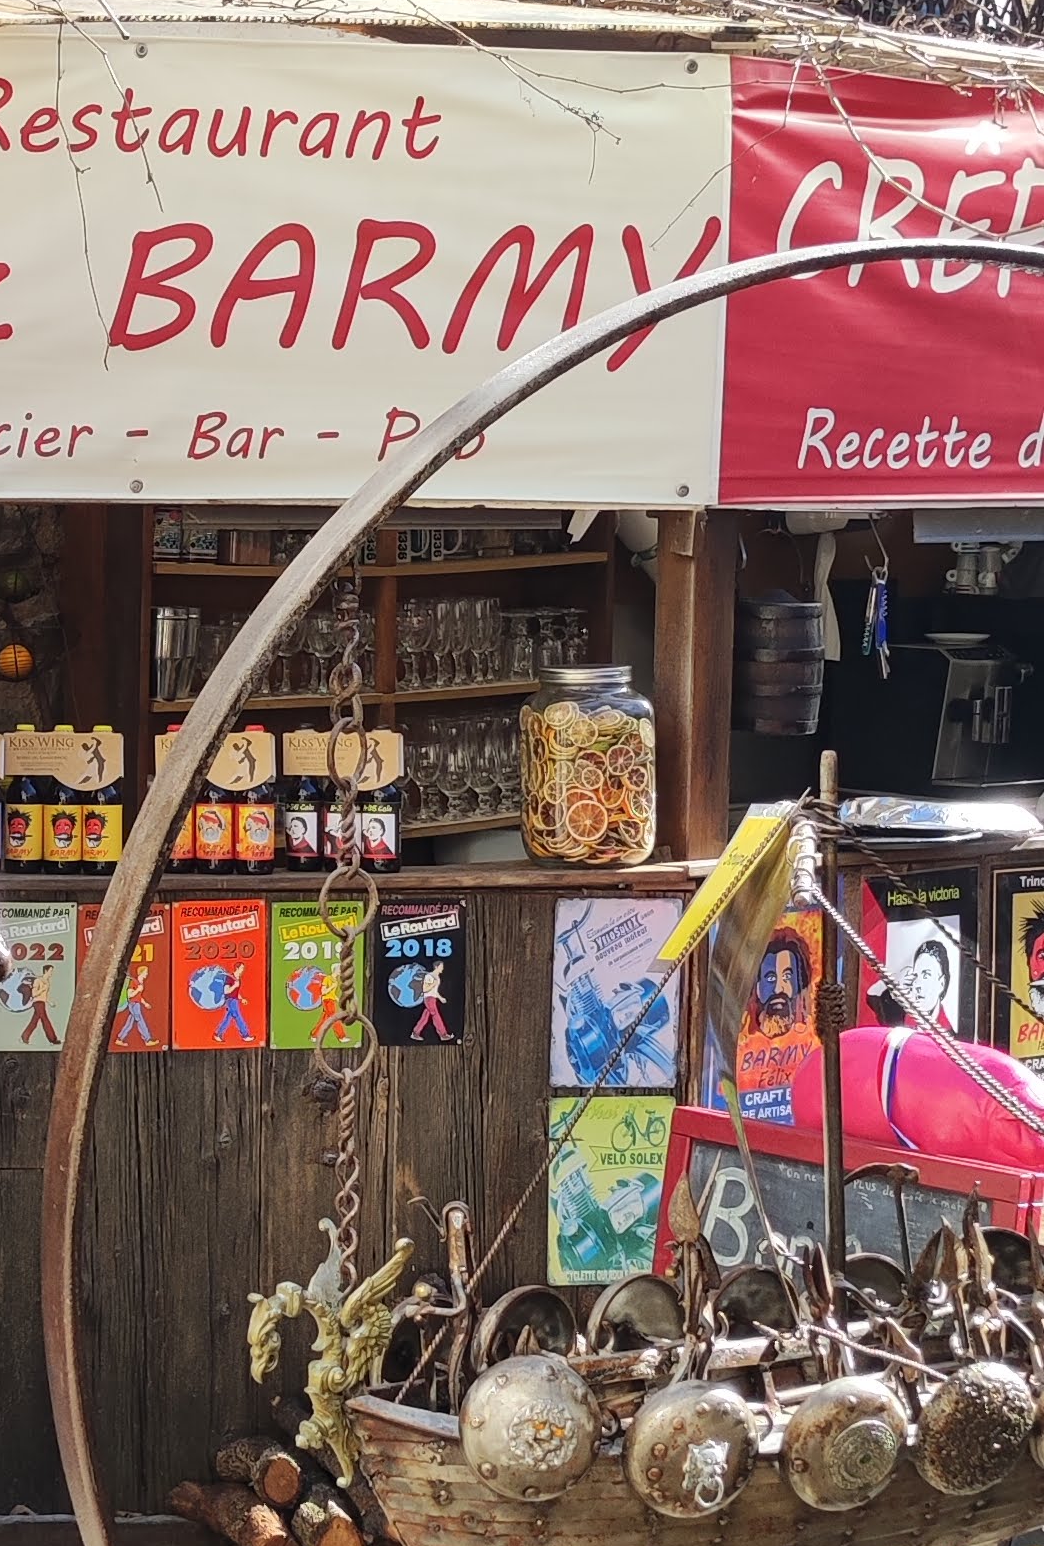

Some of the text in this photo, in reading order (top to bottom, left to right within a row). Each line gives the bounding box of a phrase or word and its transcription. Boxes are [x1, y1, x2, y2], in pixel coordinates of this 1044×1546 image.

[108, 214, 723, 373] BARMY
[186, 409, 285, 461] Bar
[796, 406, 993, 471] Recette
[928, 885, 960, 902] victoria
[10, 942, 65, 961] 022
[185, 940, 255, 960] 2020
[385, 938, 453, 958] 2018
[740, 1040, 813, 1073] BARMY
[757, 1068, 792, 1089] Félix
[744, 1088, 784, 1106] CRAFT
[599, 1151, 664, 1166] VELO SOLEX
[853, 1179, 877, 1193] PLUS
